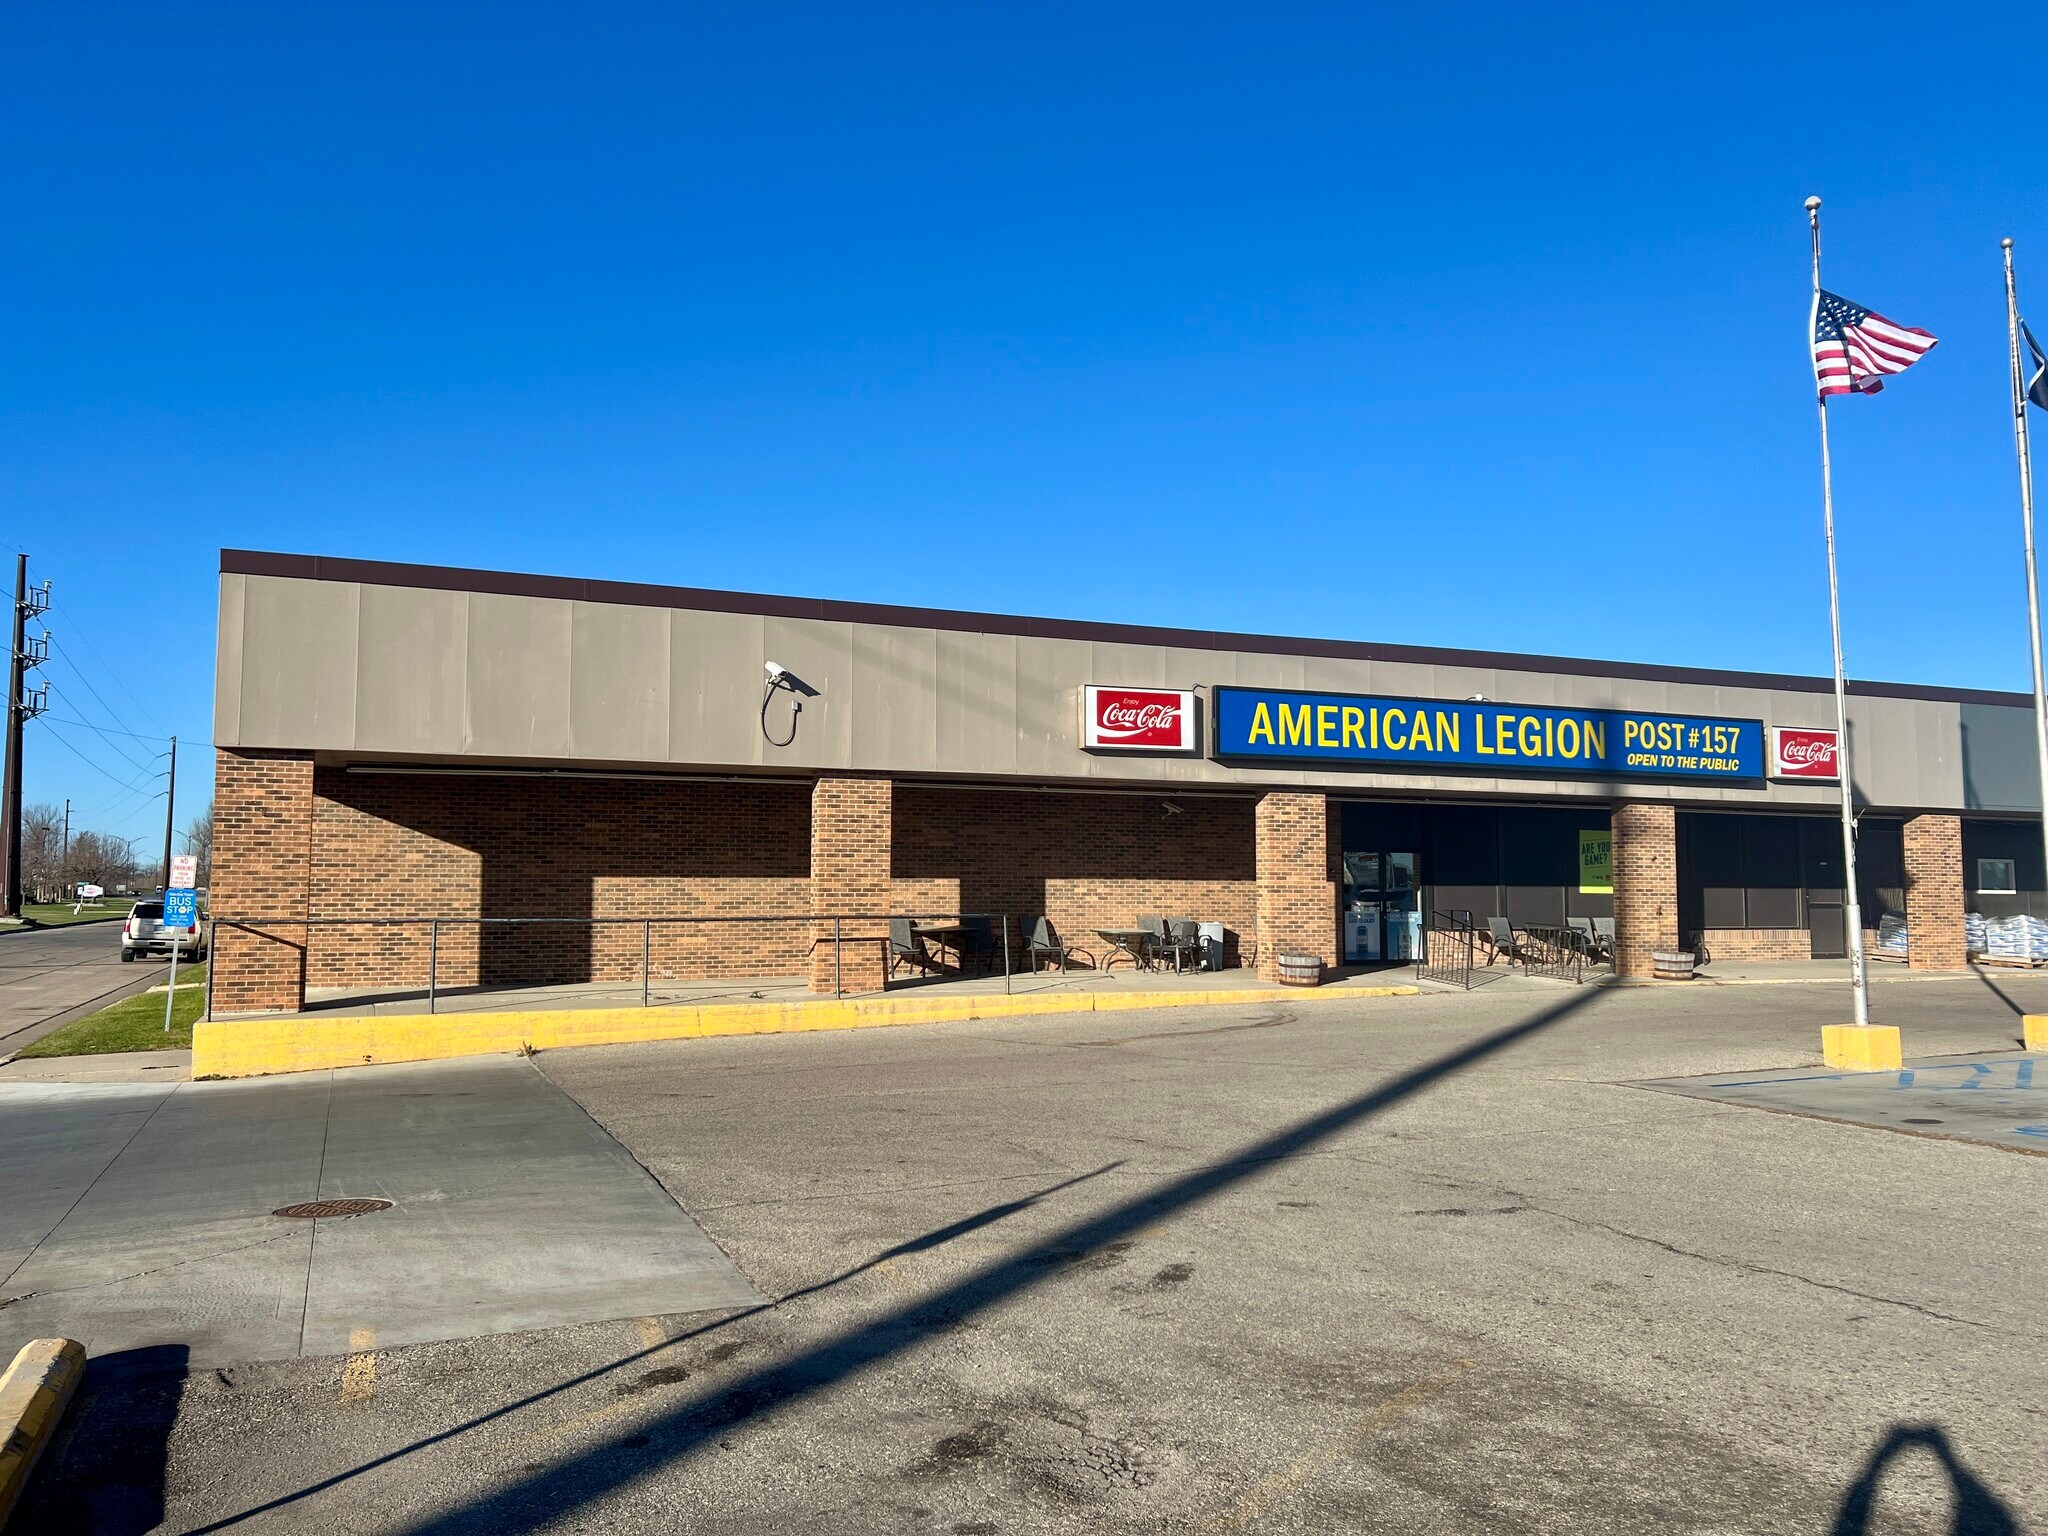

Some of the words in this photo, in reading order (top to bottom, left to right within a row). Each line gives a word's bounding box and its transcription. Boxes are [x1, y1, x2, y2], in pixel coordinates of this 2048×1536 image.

[1102, 702, 1176, 729] Coca-Cola
[1248, 702, 1459, 752] AMERICAN
[1476, 713, 1605, 759] LEGION
[1783, 740, 1833, 762] Coca-Cola
[1627, 753, 1658, 767] OPEN
[1661, 755, 1675, 768] TO
[1677, 756, 1698, 769] THE
[1700, 757, 1740, 771] PUBLIC
[1581, 843, 1595, 855] ARE
[1597, 841, 1611, 853] YOU
[1584, 853, 1608, 866] GAME?
[169, 897, 192, 905] BUS
